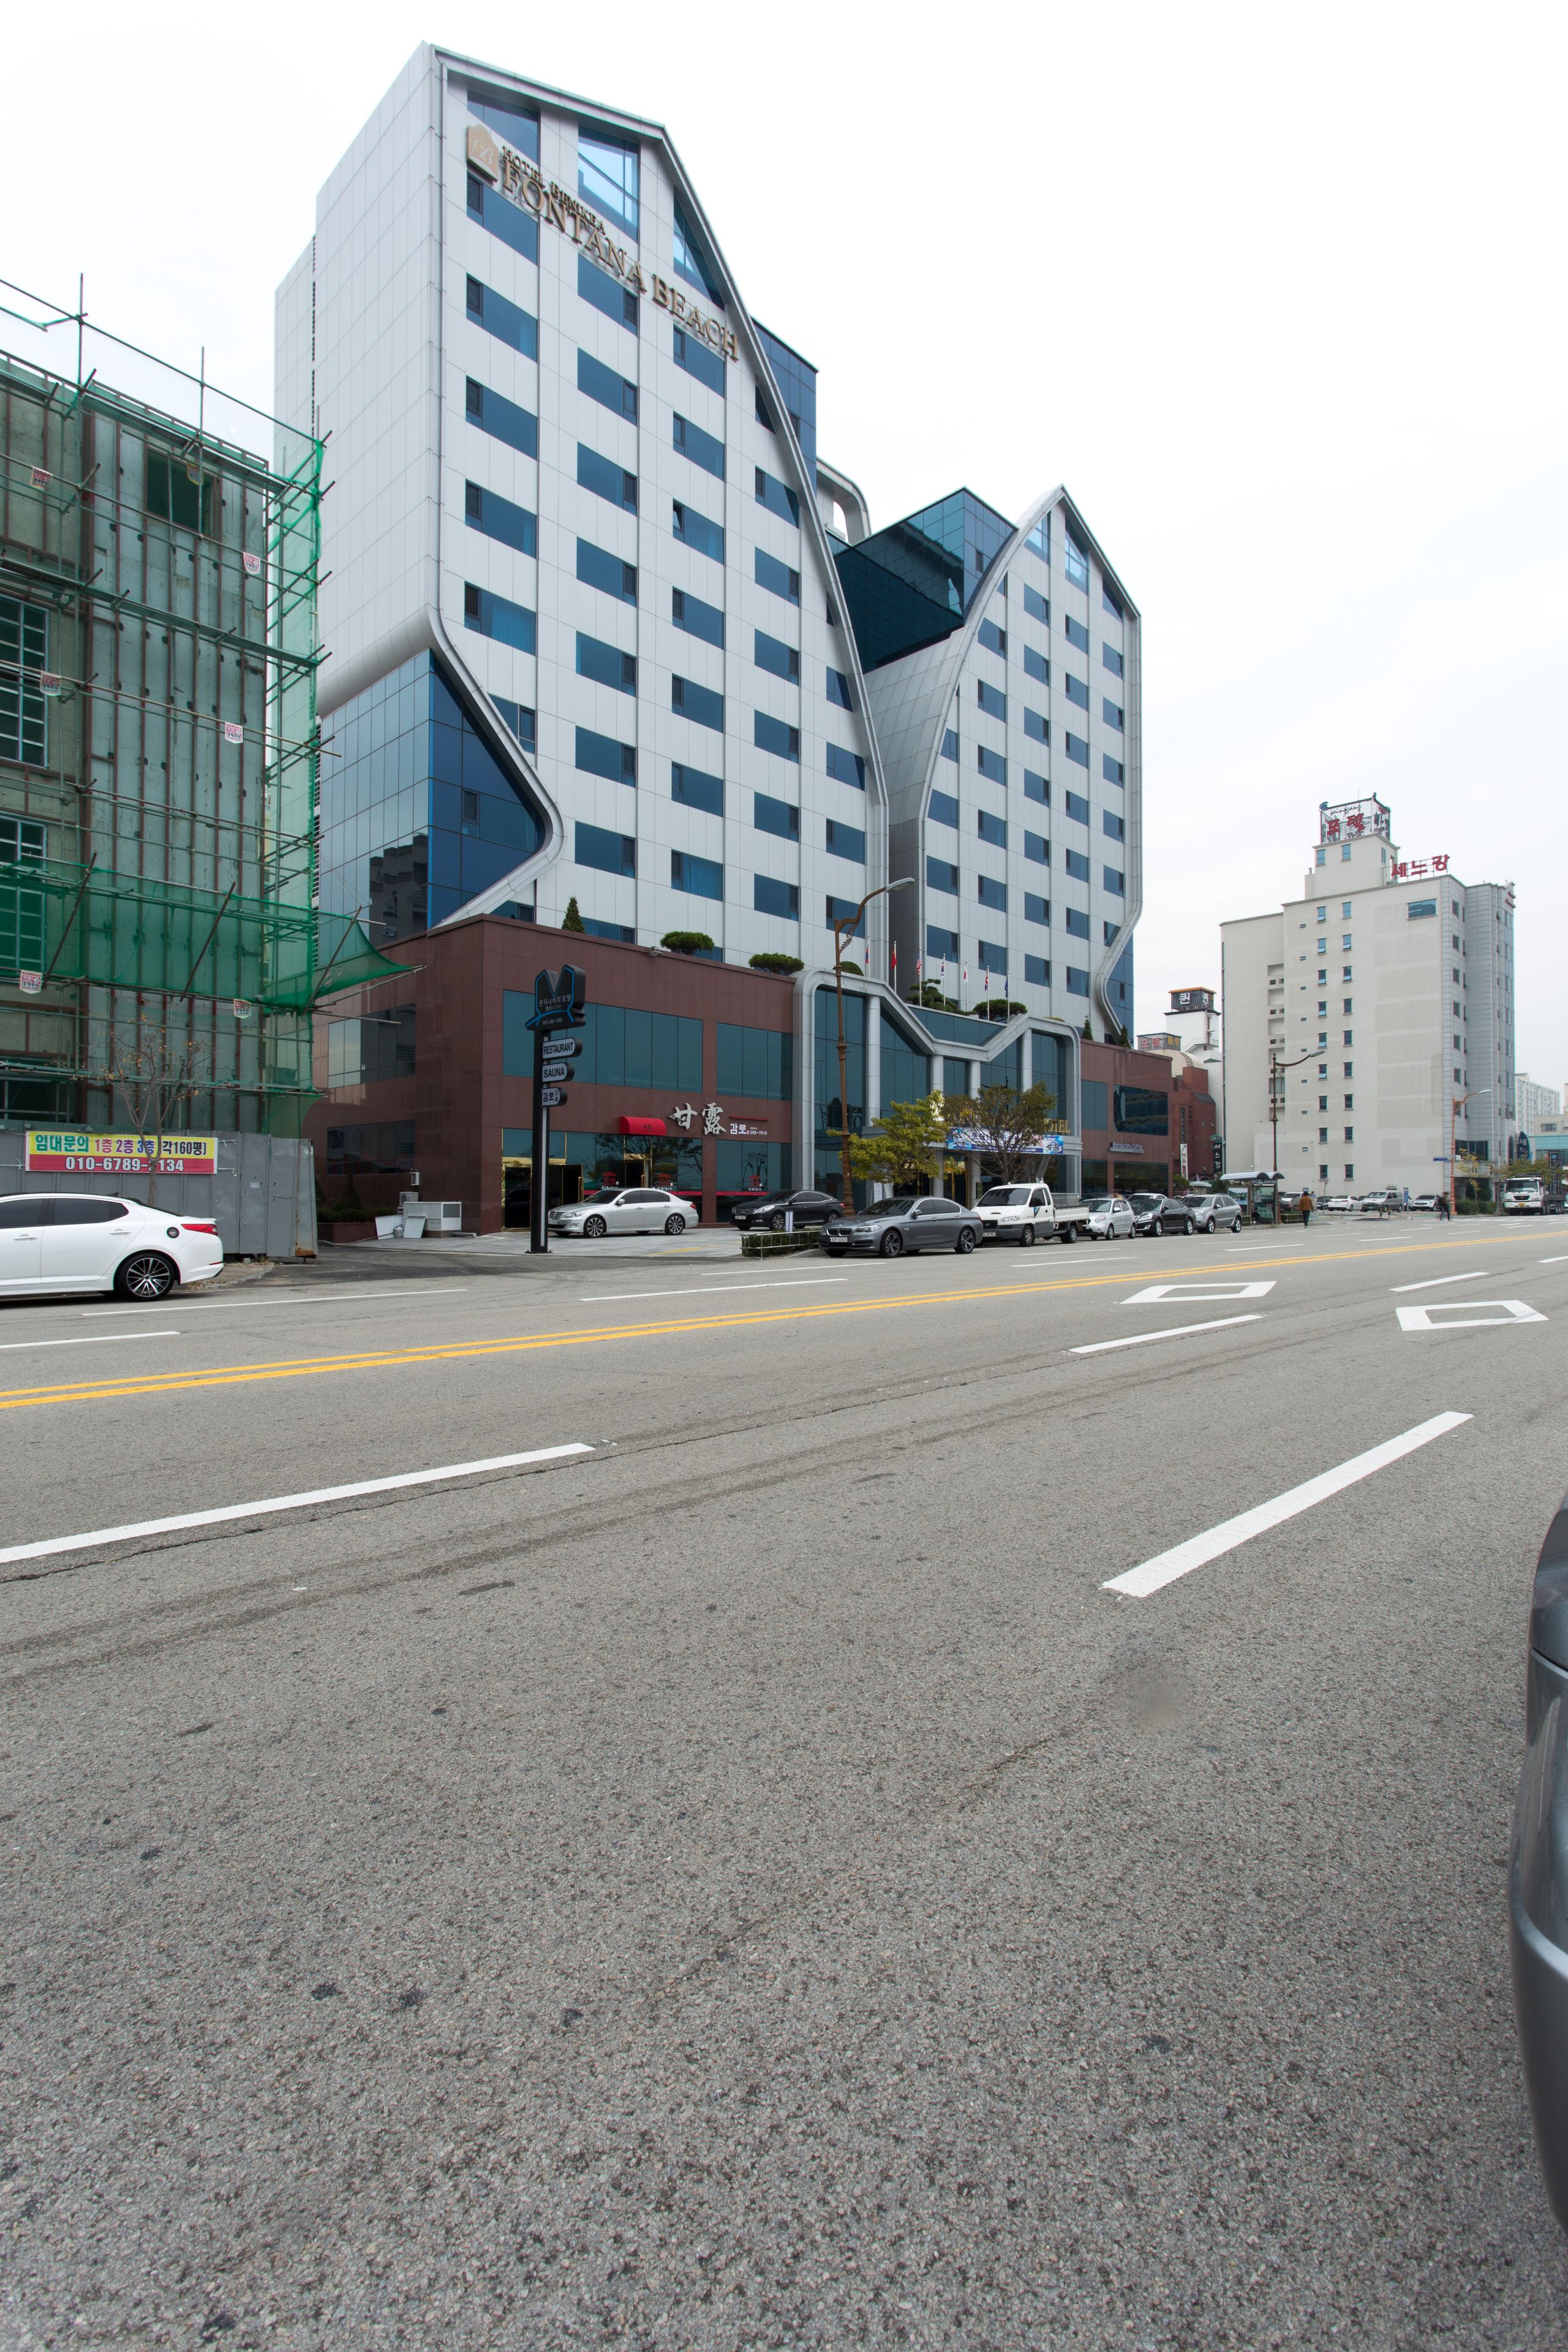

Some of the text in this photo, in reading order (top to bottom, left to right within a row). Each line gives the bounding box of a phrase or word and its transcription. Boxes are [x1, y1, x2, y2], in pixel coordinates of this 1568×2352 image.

[502, 145, 606, 236] HOTEL BENIKEA
[502, 160, 739, 361] FONTANA BEACH
[1391, 854, 1450, 877] 세느강
[544, 1042, 574, 1055] RESTAURANT
[544, 1067, 565, 1078] SAUNA
[543, 1092, 554, 1102] 감로
[669, 1102, 726, 1135] 甘露
[1041, 1118, 1071, 1133] OTEL
[730, 1123, 747, 1134] 감로
[35, 1134, 89, 1152] 임대문의
[95, 1139, 112, 1153] 1층
[116, 1139, 134, 1153] 2층
[137, 1140, 154, 1154] 3층
